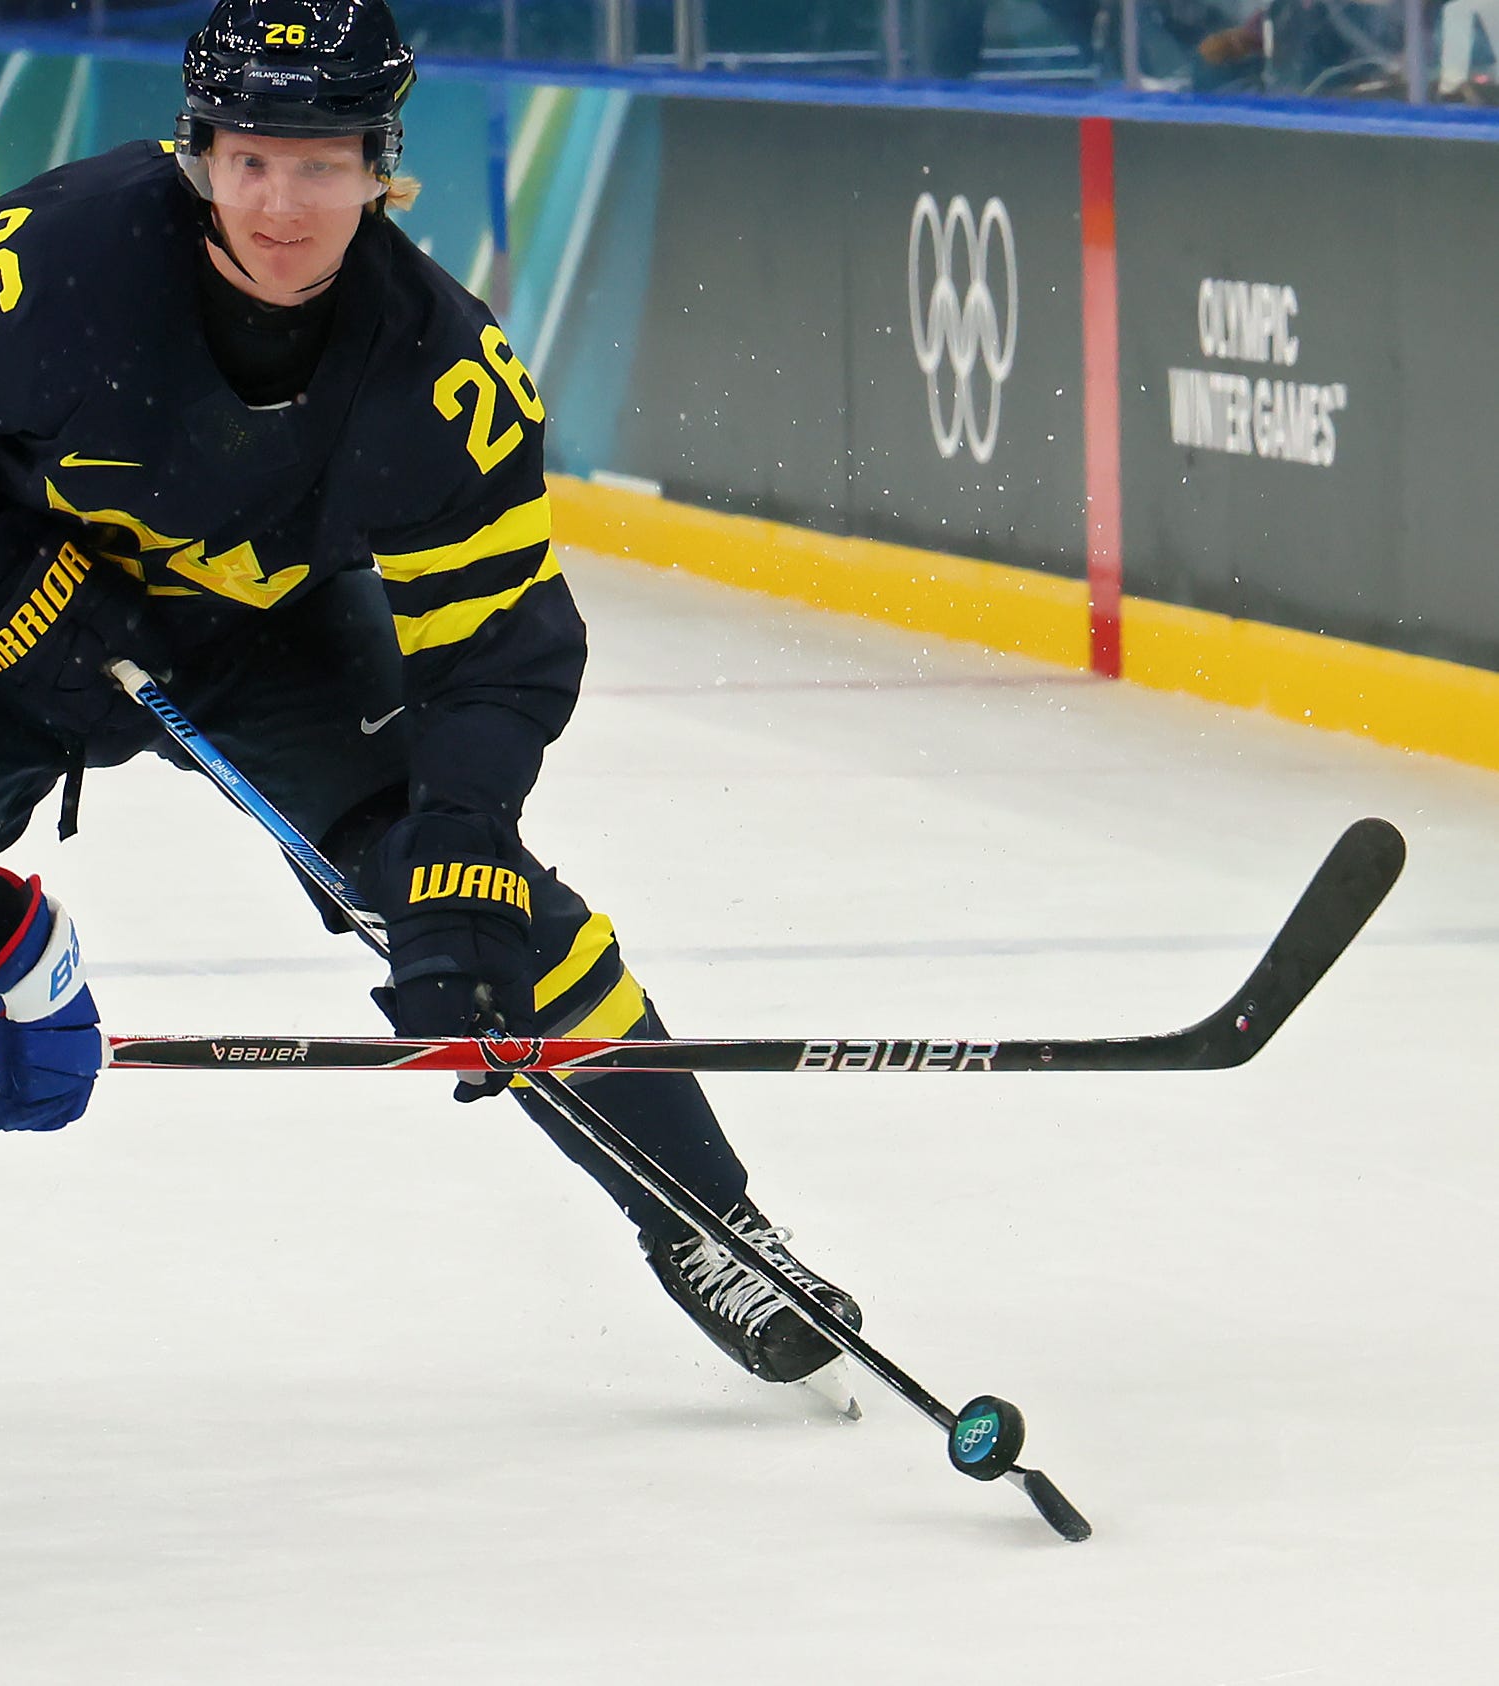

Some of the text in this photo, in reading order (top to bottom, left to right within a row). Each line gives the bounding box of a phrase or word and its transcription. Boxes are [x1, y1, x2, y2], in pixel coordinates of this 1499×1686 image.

[265, 23, 306, 45] 26
[248, 71, 313, 82] MILANO CORTINA
[433, 324, 545, 475] 26
[210, 759, 240, 786] DAHLIN
[227, 1047, 309, 1062] BAUER
[793, 1039, 1002, 1072] BAUER
